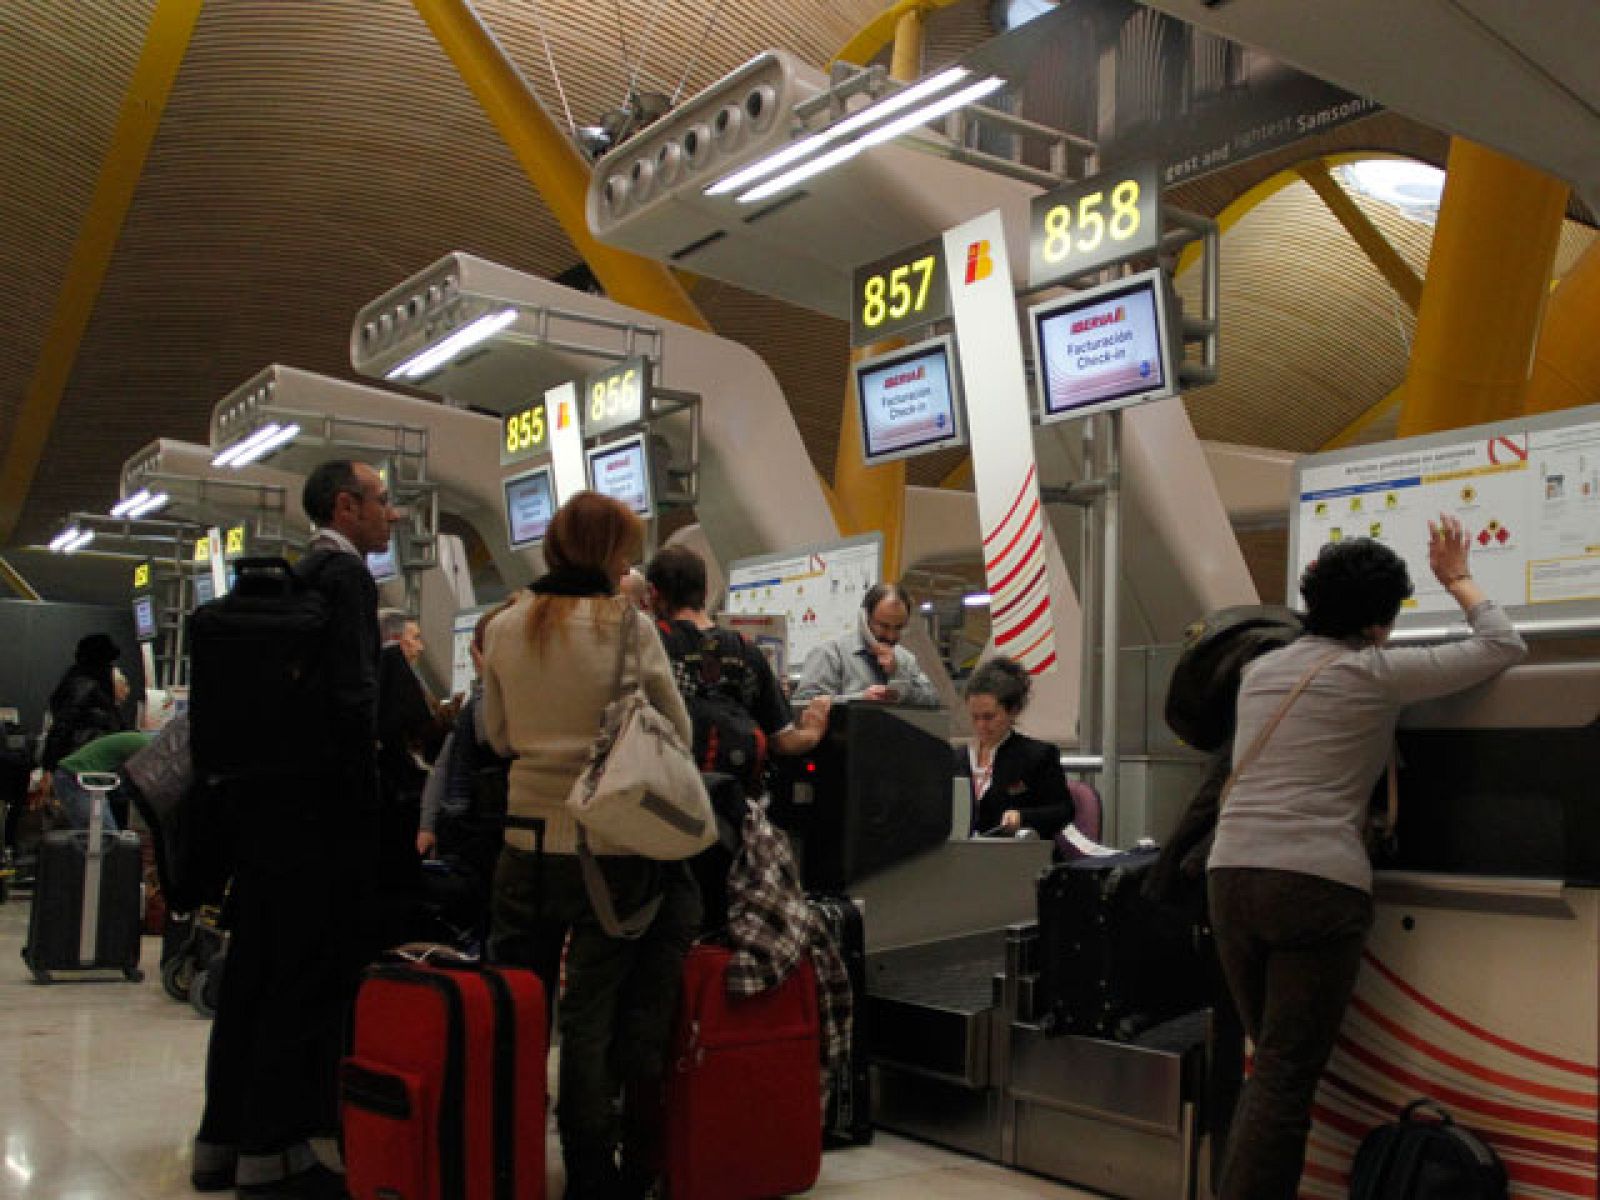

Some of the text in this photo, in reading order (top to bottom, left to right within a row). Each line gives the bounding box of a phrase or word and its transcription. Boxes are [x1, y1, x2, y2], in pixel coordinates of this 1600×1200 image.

[1043, 179, 1142, 264] 858
[862, 254, 936, 329] 857
[591, 368, 637, 422] 856
[506, 405, 545, 453] 855
